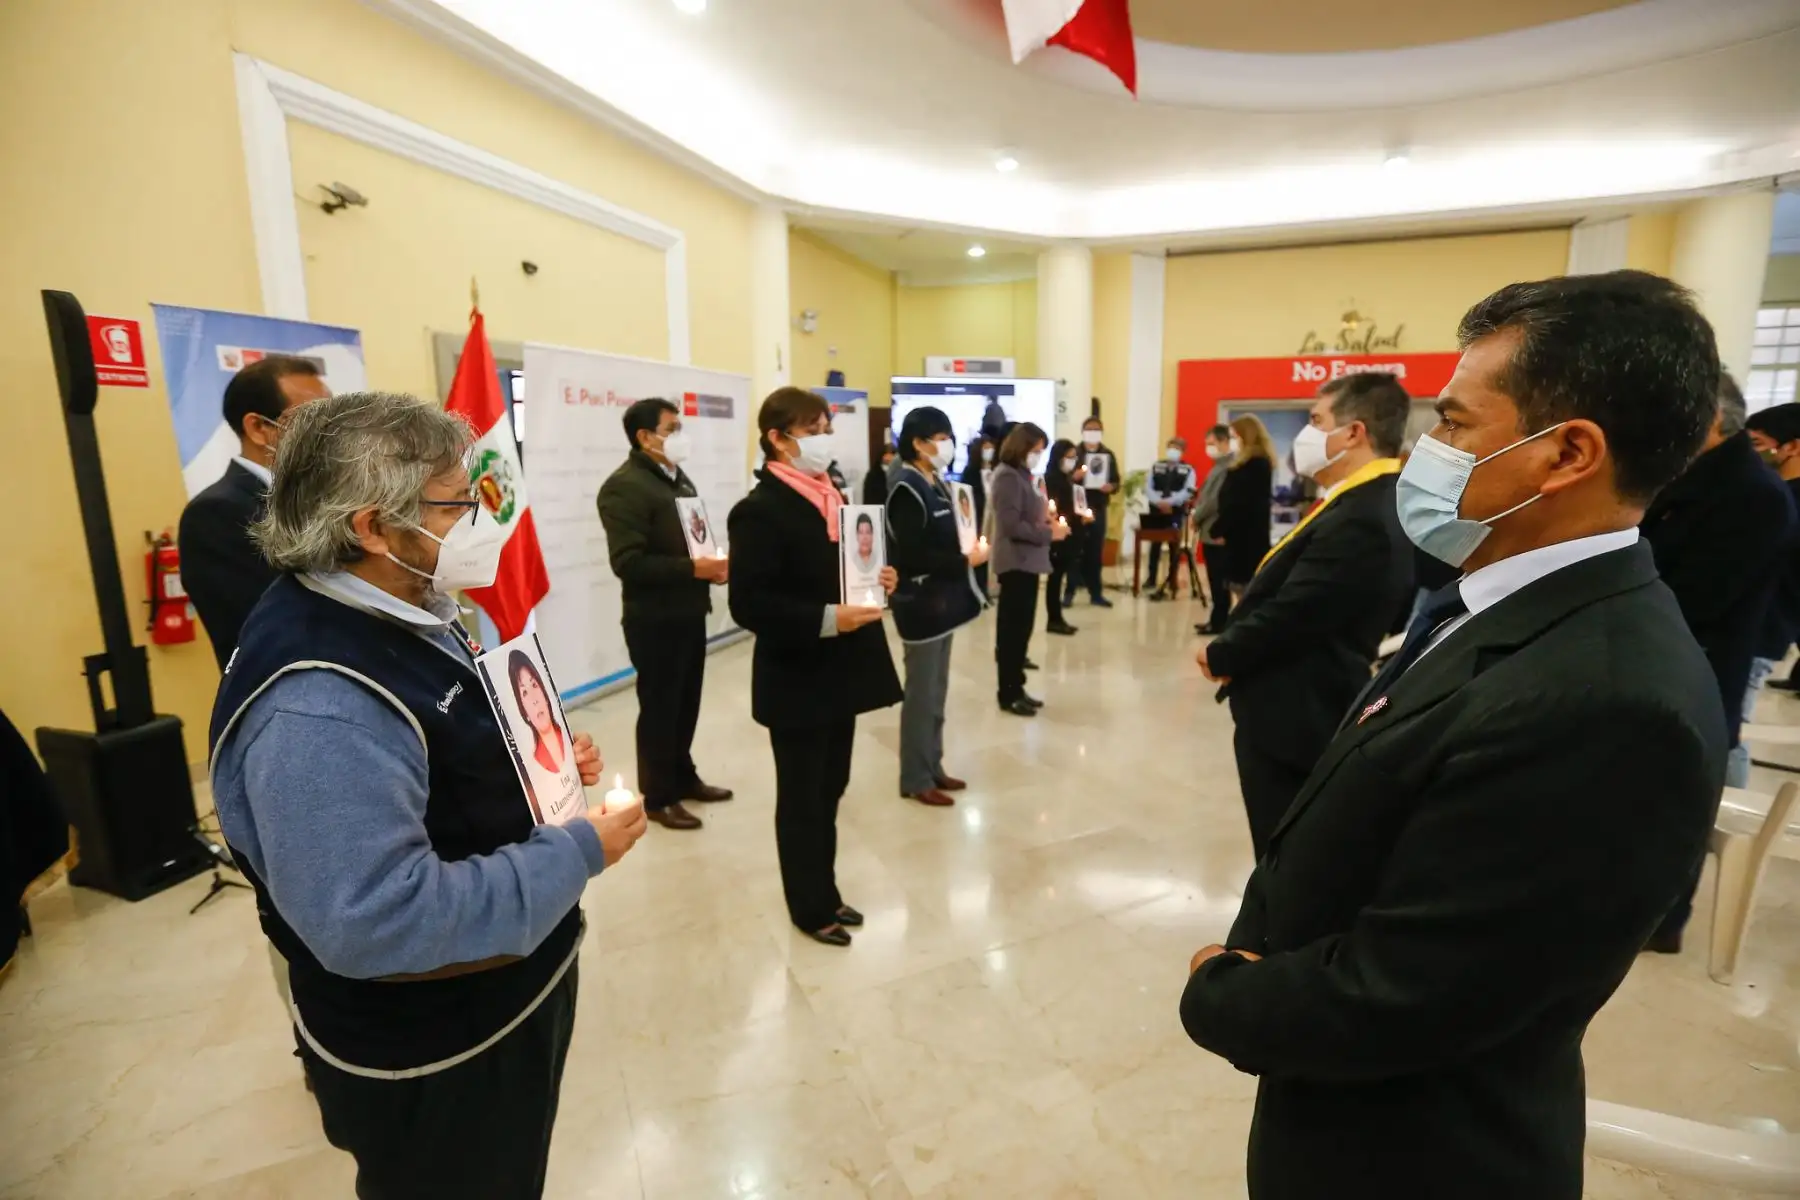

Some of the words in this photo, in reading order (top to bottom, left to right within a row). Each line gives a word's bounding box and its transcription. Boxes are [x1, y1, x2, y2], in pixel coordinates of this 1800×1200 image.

[1296, 329, 1325, 355] La
[1334, 322, 1406, 356] Salud
[1292, 360, 1327, 382] No
